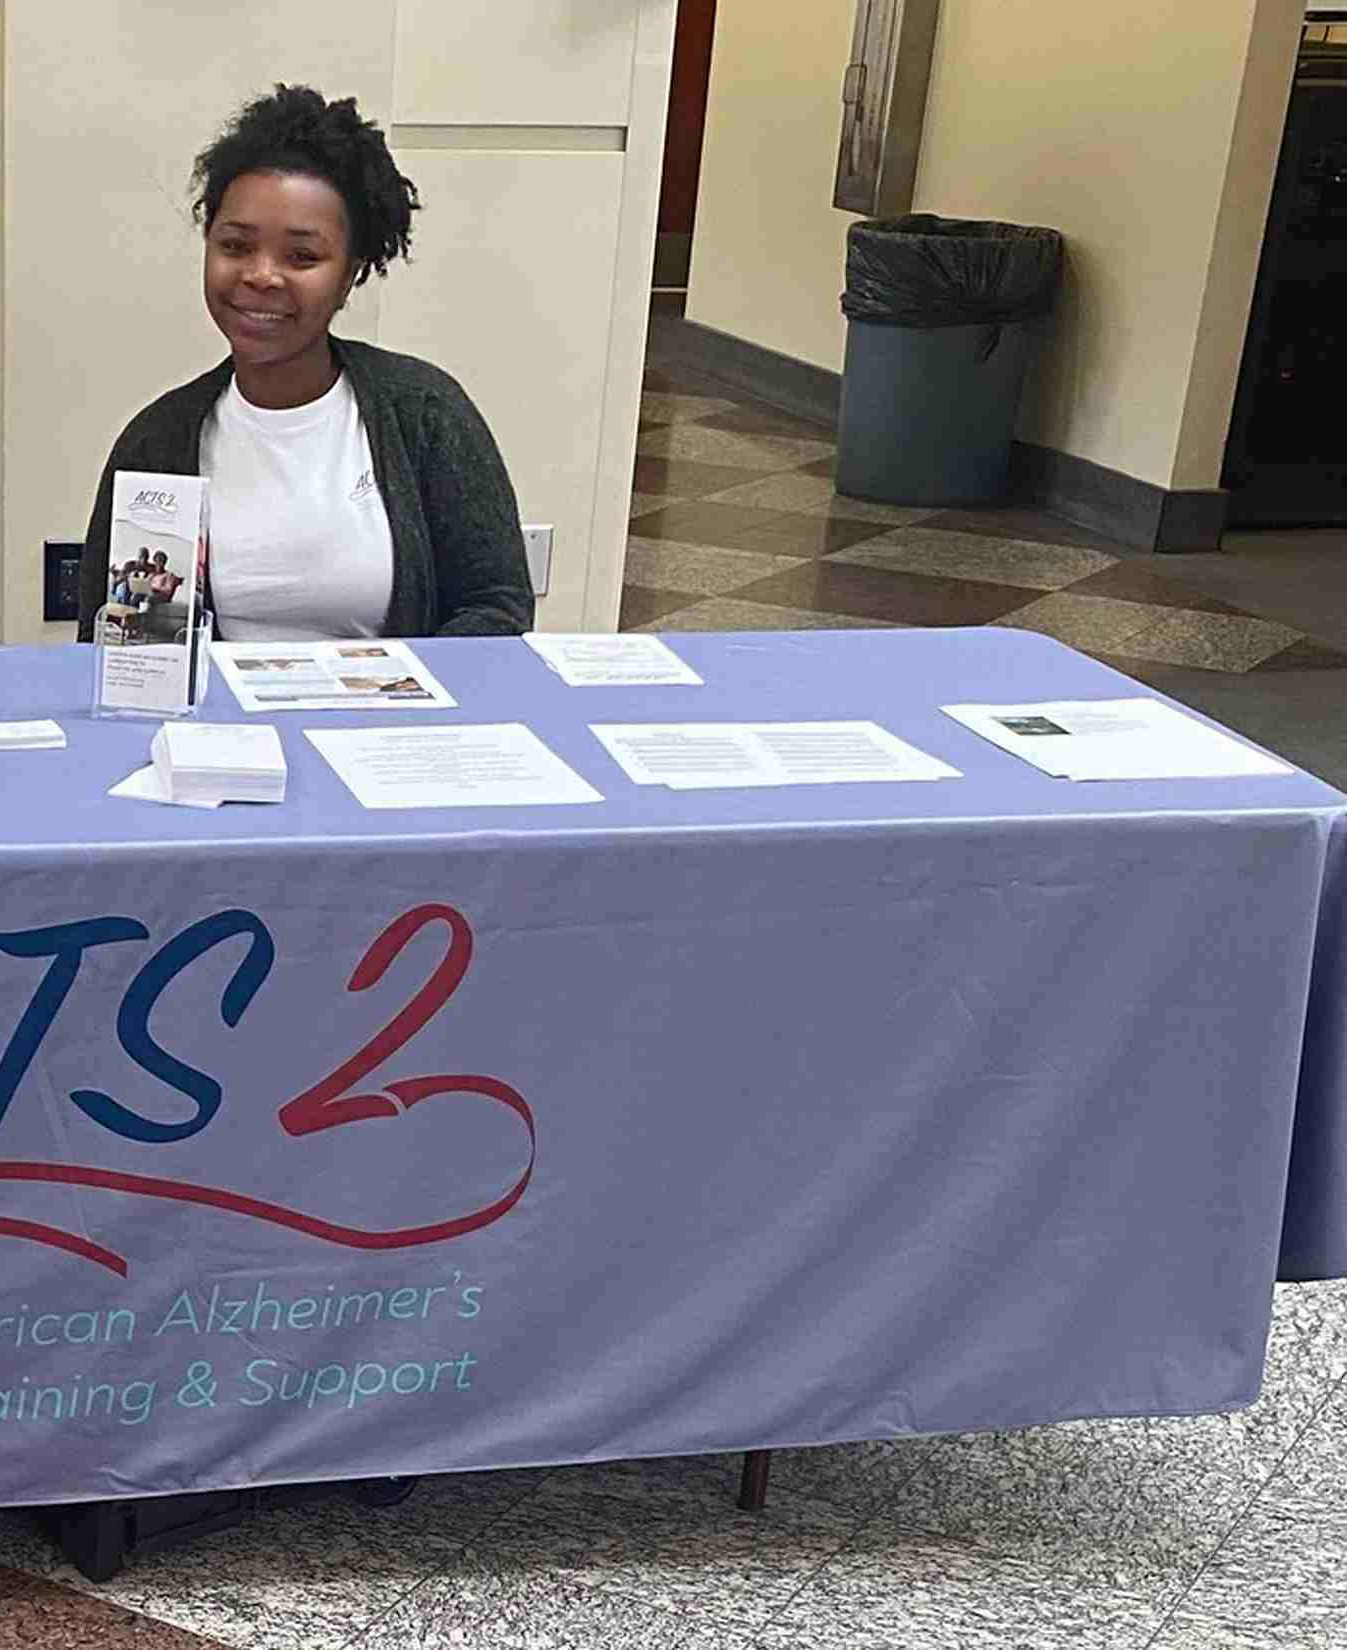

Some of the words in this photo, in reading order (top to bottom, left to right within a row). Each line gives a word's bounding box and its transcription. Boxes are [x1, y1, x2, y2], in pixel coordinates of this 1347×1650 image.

[278, 903, 472, 1138] 2
[176, 1360, 216, 1410] &
[240, 1351, 478, 1409] Support
